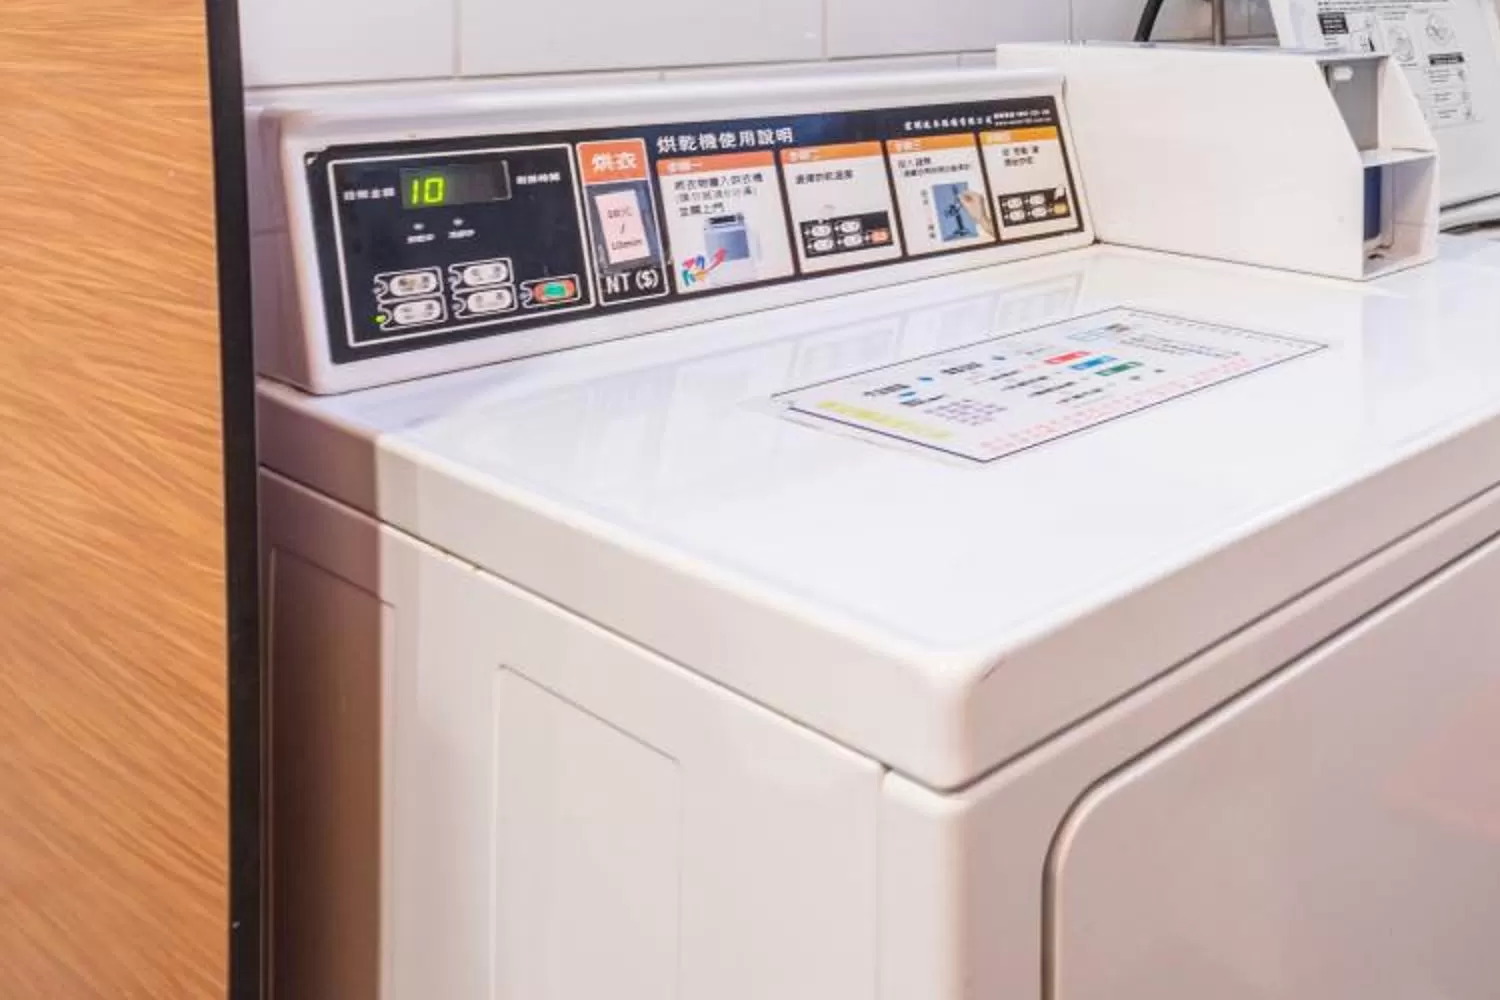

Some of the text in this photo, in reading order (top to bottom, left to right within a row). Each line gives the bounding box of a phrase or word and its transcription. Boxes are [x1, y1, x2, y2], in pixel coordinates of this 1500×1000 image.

[656, 127, 793, 154] 烘乾機使用說明
[411, 176, 445, 205] 10
[606, 268, 659, 294] NT ($)
